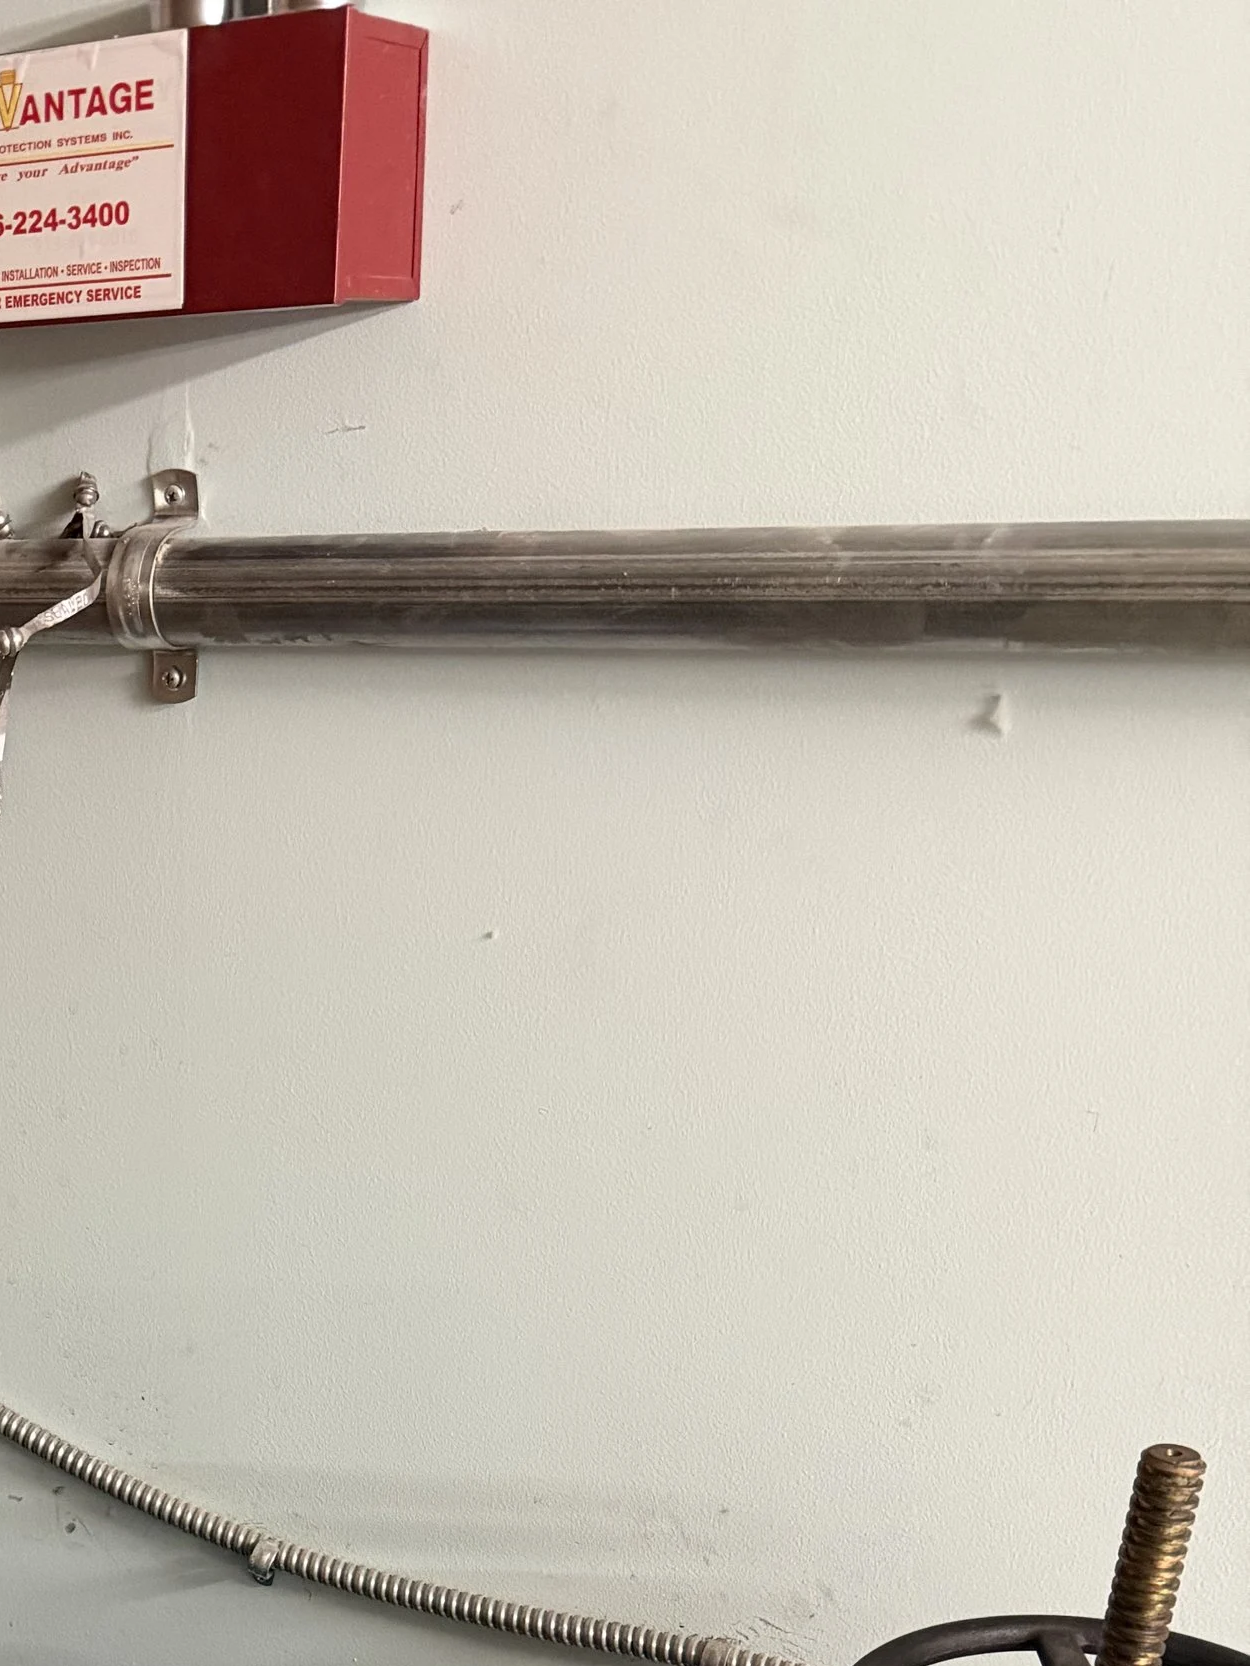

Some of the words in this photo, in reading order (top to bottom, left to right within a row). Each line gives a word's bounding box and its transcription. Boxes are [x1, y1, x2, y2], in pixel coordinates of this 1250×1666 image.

[56, 133, 107, 148] SYSTEMS
[112, 129, 134, 141] INC.
[16, 167, 48, 181] your
[1, 265, 59, 282] INSTALLATION
[66, 262, 102, 276] SERVICE
[109, 256, 161, 274] INSPECTION
[4, 289, 83, 309] EMERGENCY
[85, 285, 142, 302] SERVICE
